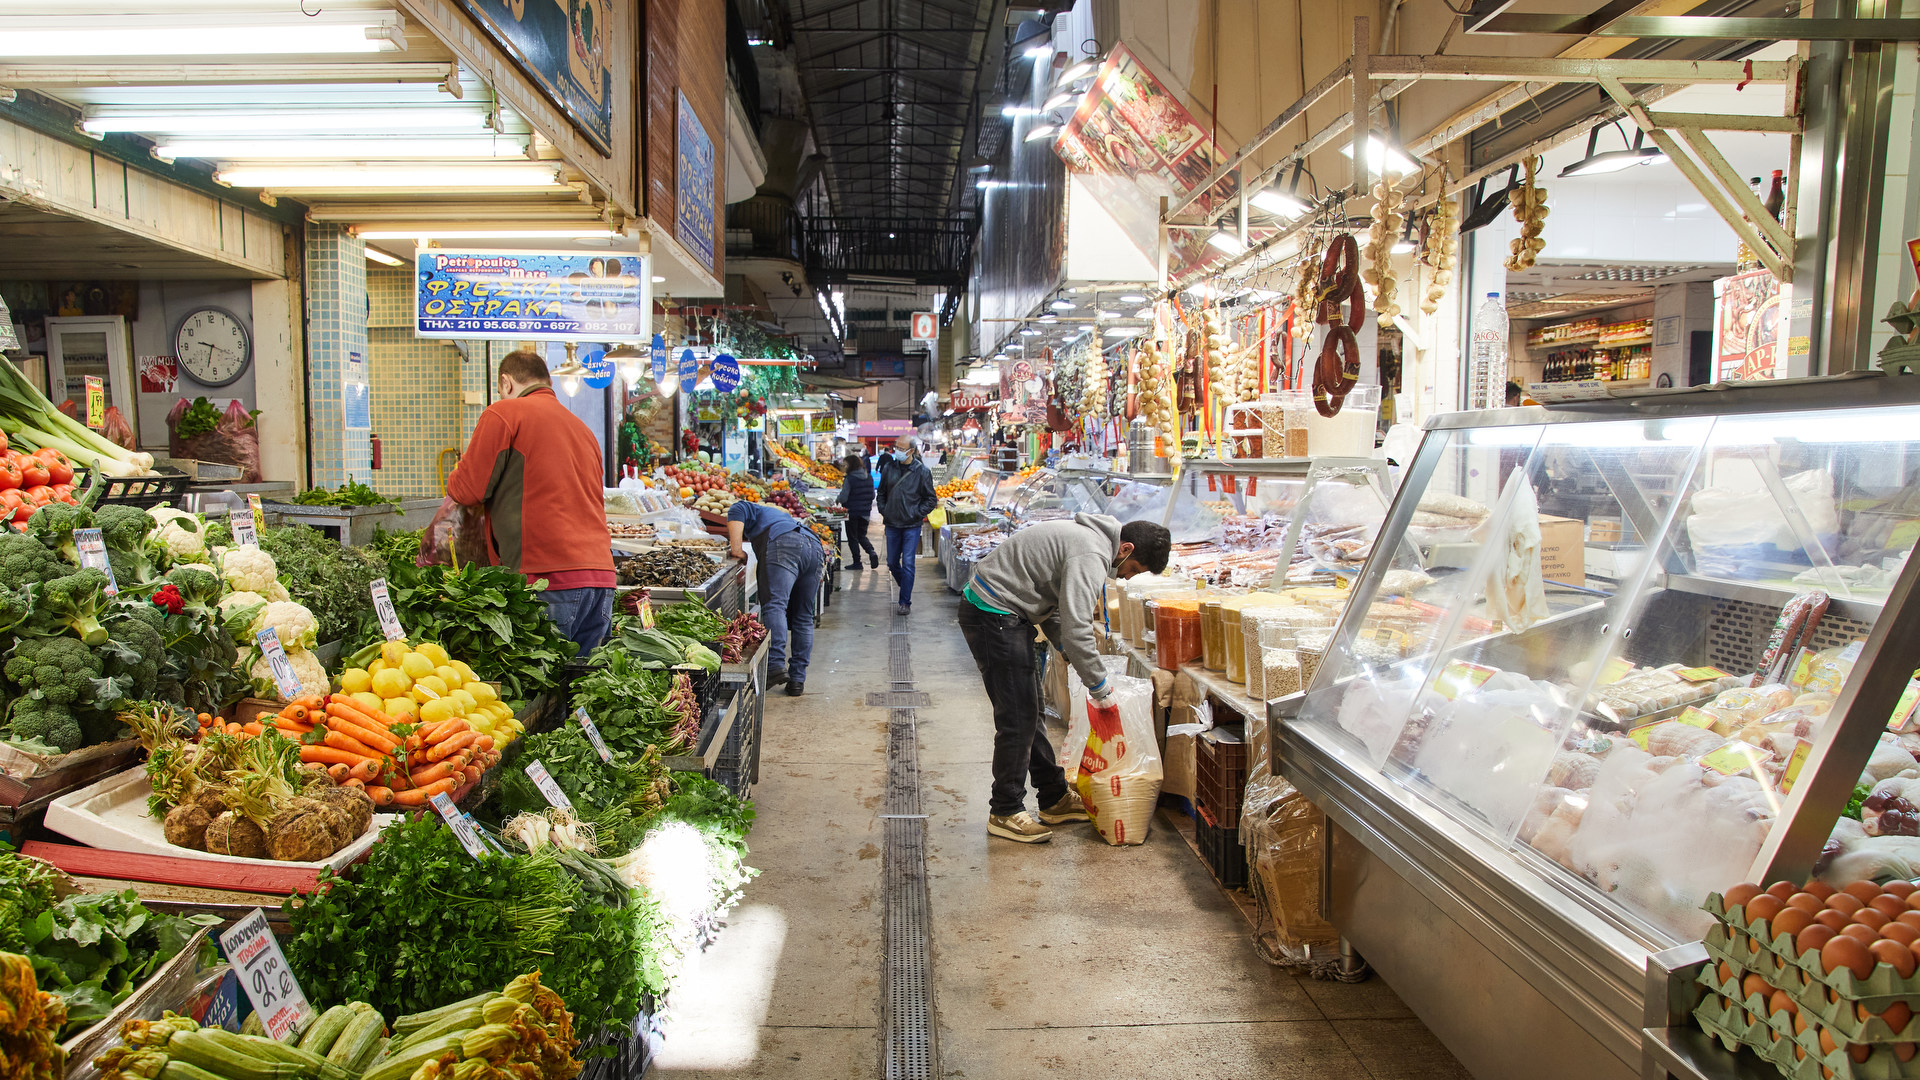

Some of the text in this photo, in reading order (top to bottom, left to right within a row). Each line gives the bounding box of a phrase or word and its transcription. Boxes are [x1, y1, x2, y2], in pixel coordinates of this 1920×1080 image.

[426, 281, 561, 296] ΦΡΕΣΚΑ
[425, 299, 562, 316] ΟΣΤΡΑΚΑ
[423, 320, 454, 329] ΤΗΛ:
[457, 320, 480, 329] 210
[585, 322, 608, 331] 082
[613, 322, 634, 331] 107
[279, 970, 293, 999] €
